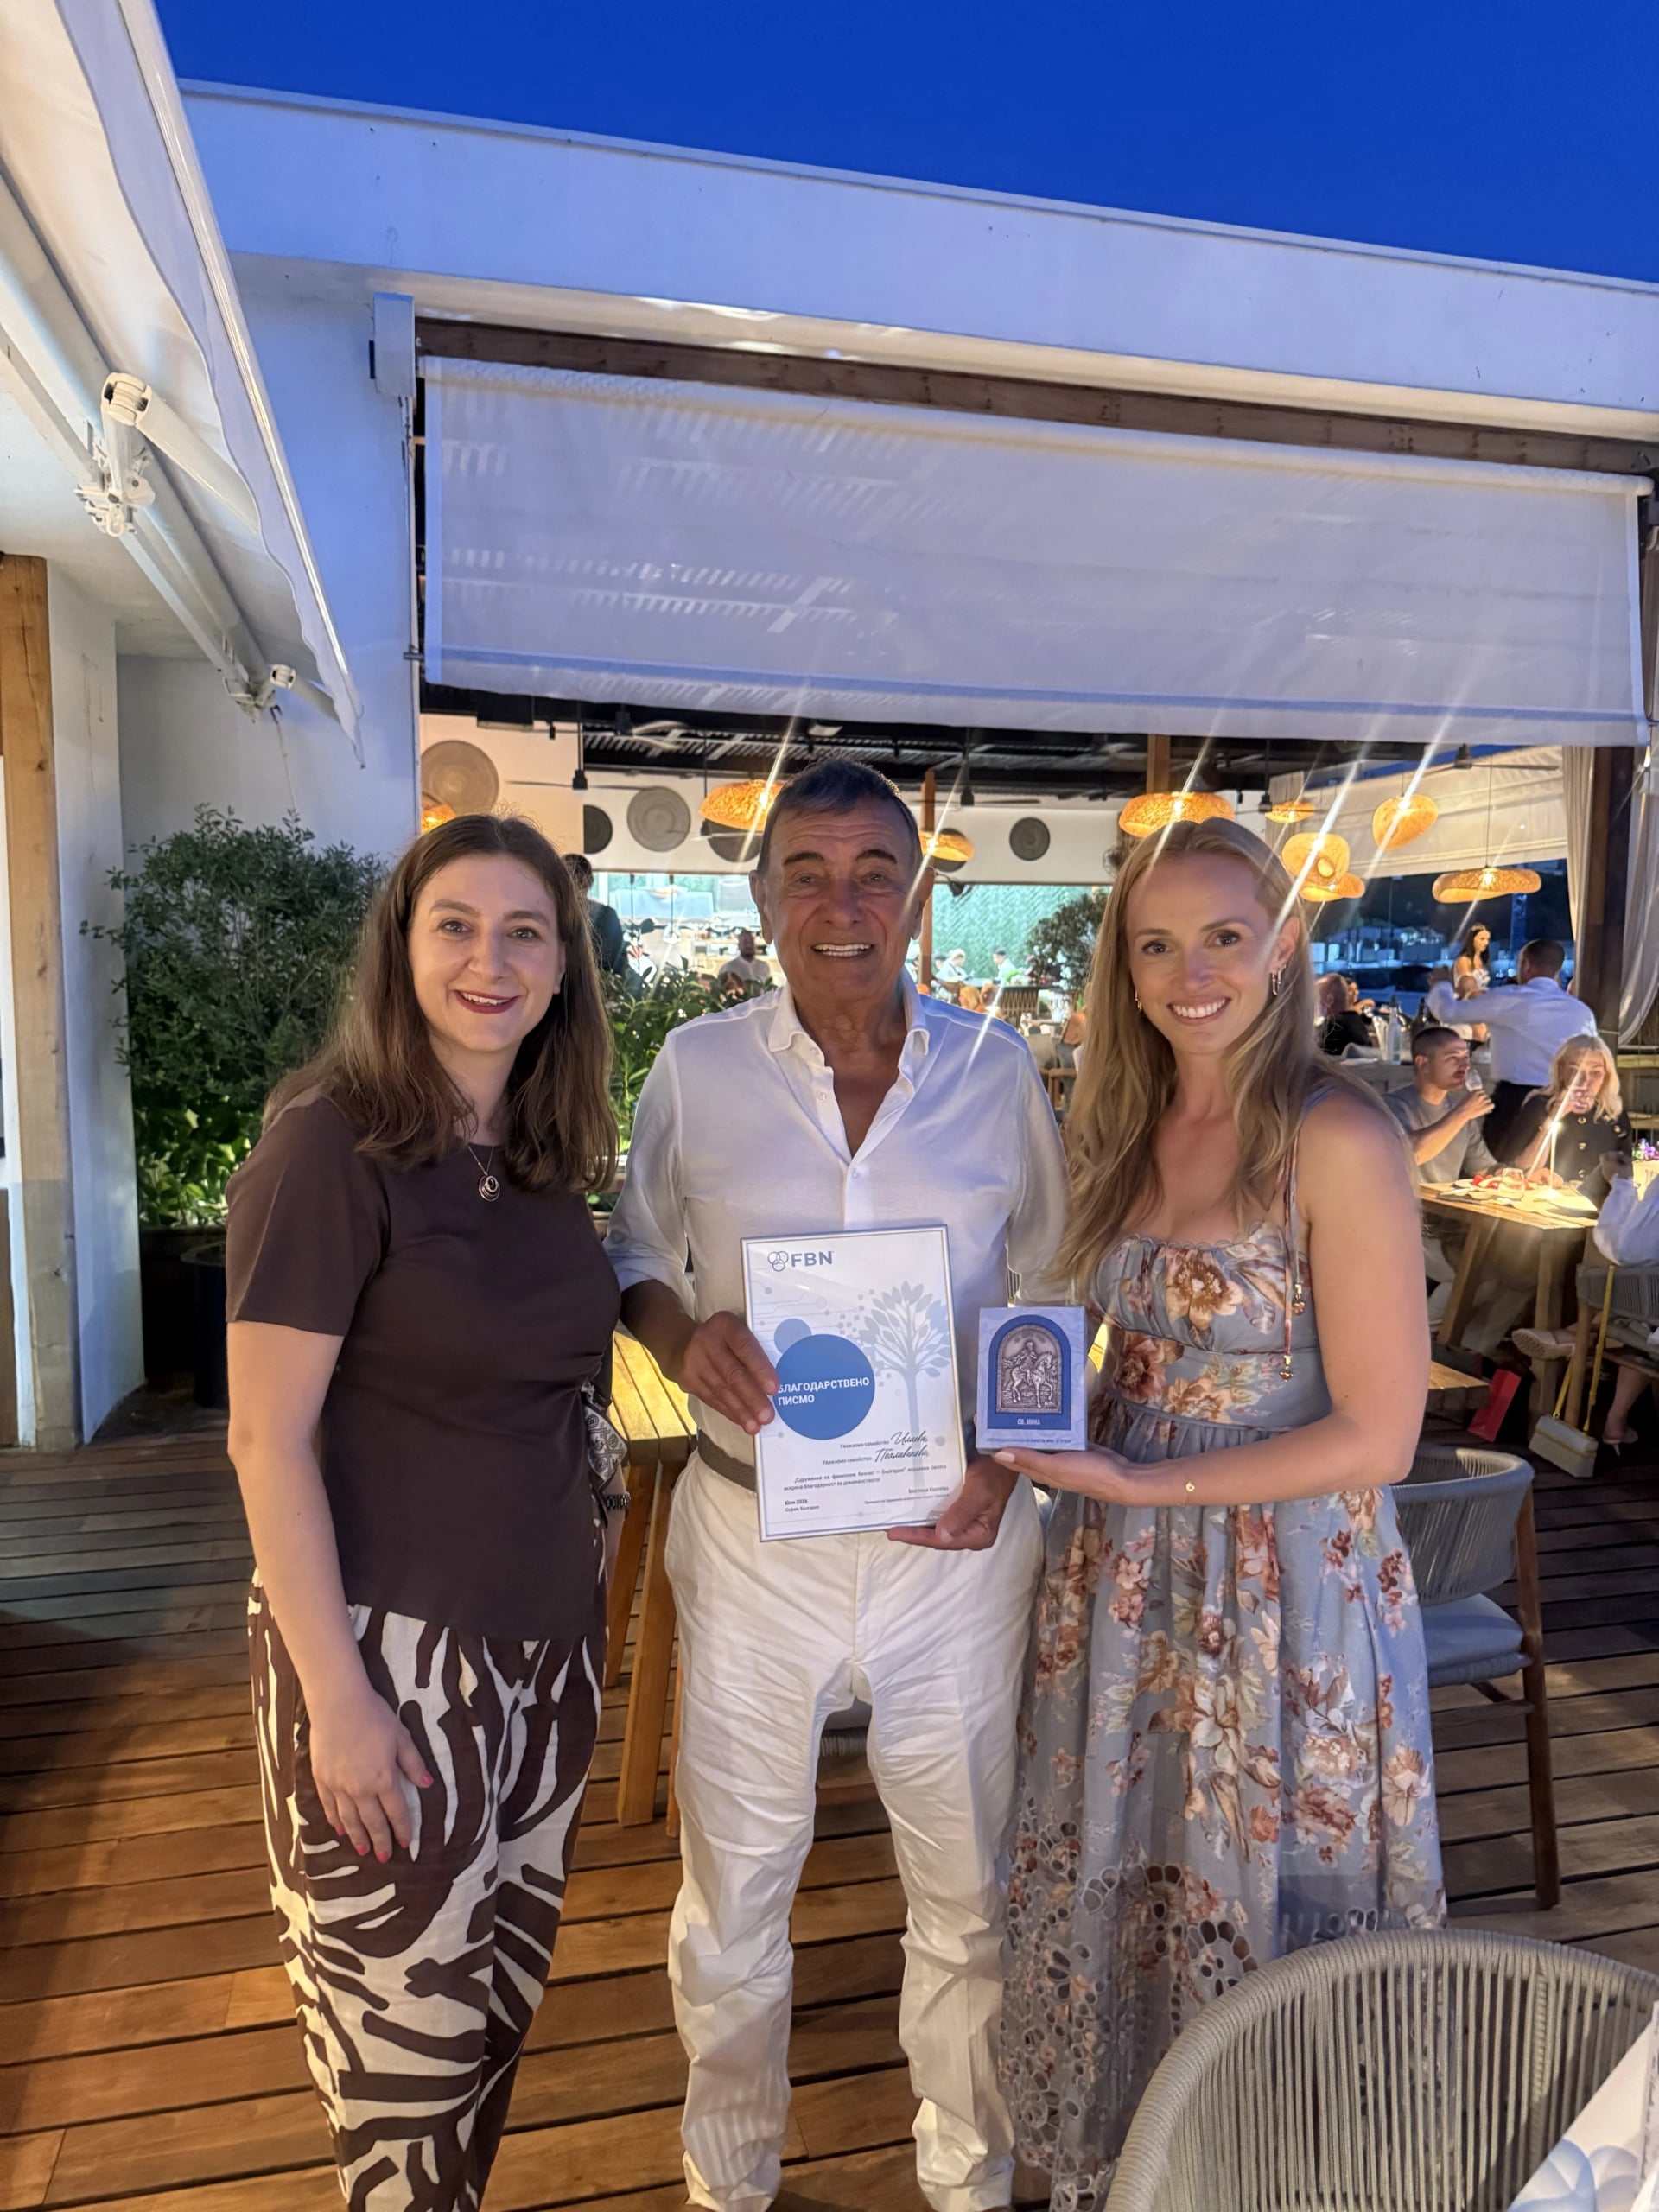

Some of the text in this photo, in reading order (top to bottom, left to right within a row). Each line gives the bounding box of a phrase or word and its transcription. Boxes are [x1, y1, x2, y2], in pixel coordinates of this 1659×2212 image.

[791, 1250, 832, 1268] FBN
[778, 1377, 869, 1393] БЛАГОДАРСТВЕНО
[778, 1394, 815, 1406] ПИСМО
